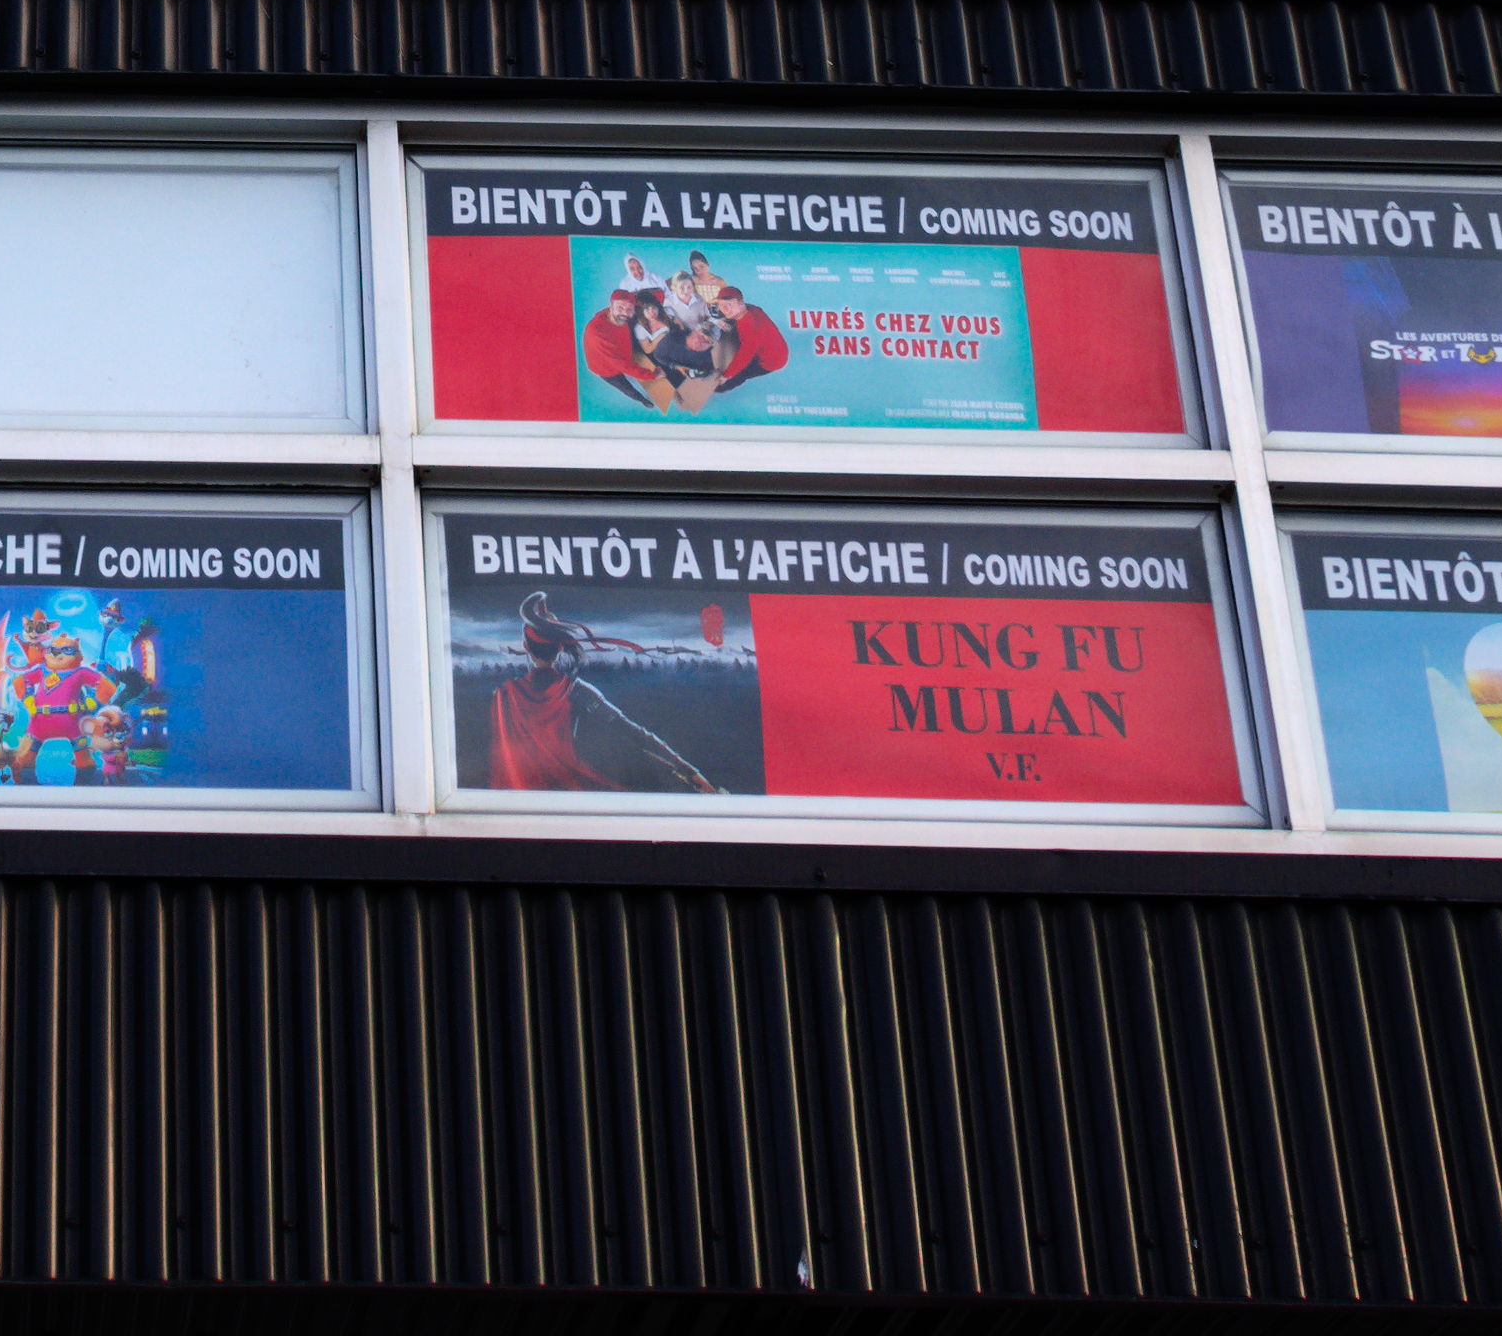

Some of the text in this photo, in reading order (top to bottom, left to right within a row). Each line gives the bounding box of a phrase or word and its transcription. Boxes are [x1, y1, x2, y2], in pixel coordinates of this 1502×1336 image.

[451, 181, 627, 226] BIENTÔT
[642, 182, 670, 228] À
[680, 192, 886, 233] L'AFFICHE
[920, 207, 1041, 236] COMING
[1049, 210, 1134, 240] SOON
[1258, 200, 1436, 248] BIENTÔT
[1452, 202, 1483, 250] À
[789, 306, 1001, 335] LIVRÉS CHEZ VOUS
[1396, 331, 1418, 342] LES
[1419, 332, 1490, 343] AVENTURES
[815, 335, 980, 360] SANS CONTACT
[98, 546, 224, 578] COMING
[233, 547, 320, 579] SOON
[472, 528, 657, 578] BIENTÔT
[672, 528, 702, 579] À
[713, 538, 929, 584] L'AFFICHE
[963, 553, 1091, 587] COMING
[1099, 556, 1189, 589] SOON
[847, 620, 1145, 673] KUNG FU
[884, 683, 1127, 738] MULAN
[985, 752, 1042, 782] V.F.
